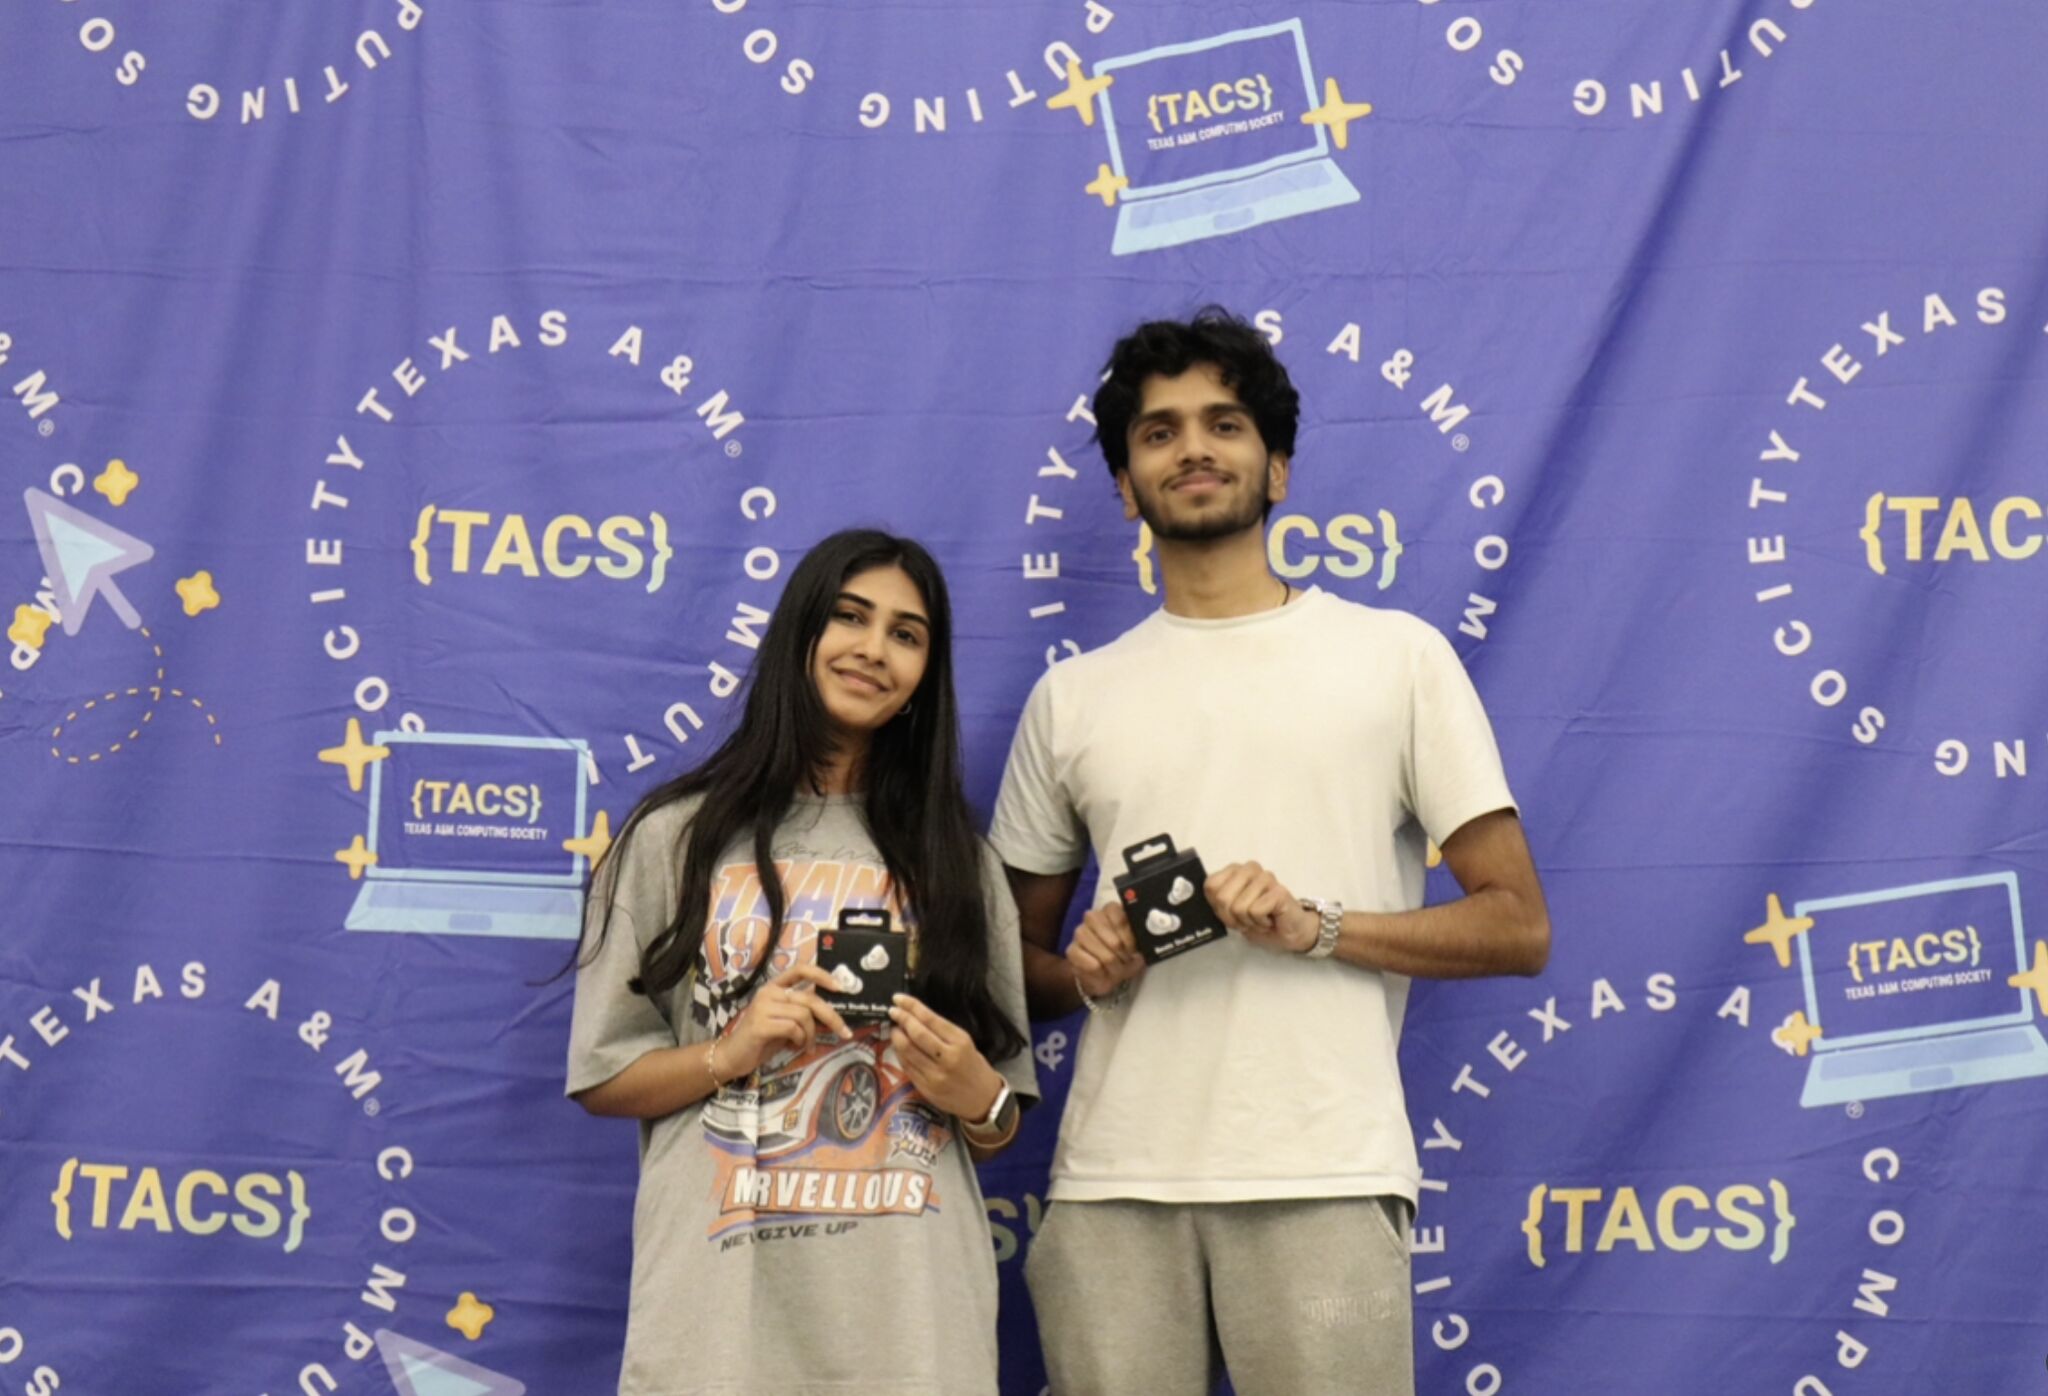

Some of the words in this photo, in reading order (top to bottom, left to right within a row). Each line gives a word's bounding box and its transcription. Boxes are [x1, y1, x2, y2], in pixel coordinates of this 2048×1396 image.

[1146, 136, 1176, 151] TEXAS
[1199, 120, 1249, 140] COMPUTING
[1248, 110, 1285, 131] SOCIETY
[1147, 73, 1274, 135] {TACS}
[356, 309, 568, 424] TEXAS
[1786, 287, 2008, 411] TEXAS
[409, 503, 675, 593] {TACS}
[1131, 508, 1404, 593] {CS}
[403, 822, 433, 836] TEXAS
[456, 825, 508, 839] COMPUTING
[509, 827, 548, 841] SOCIETY
[411, 778, 543, 825] {TACS}
[1844, 984, 1876, 1000] TEXAS
[1901, 974, 1954, 992] COMPUTING
[1954, 969, 1993, 986] SOCIETY
[1847, 925, 1981, 983] {TACS}
[0, 961, 207, 1071] TEXAS
[1451, 973, 1677, 1100] TEXAS
[49, 1157, 312, 1254] {TACS}
[756, 1223, 819, 1242] GIVE
[824, 1220, 859, 1236] UP
[1520, 1177, 1798, 1269] {TACS}
